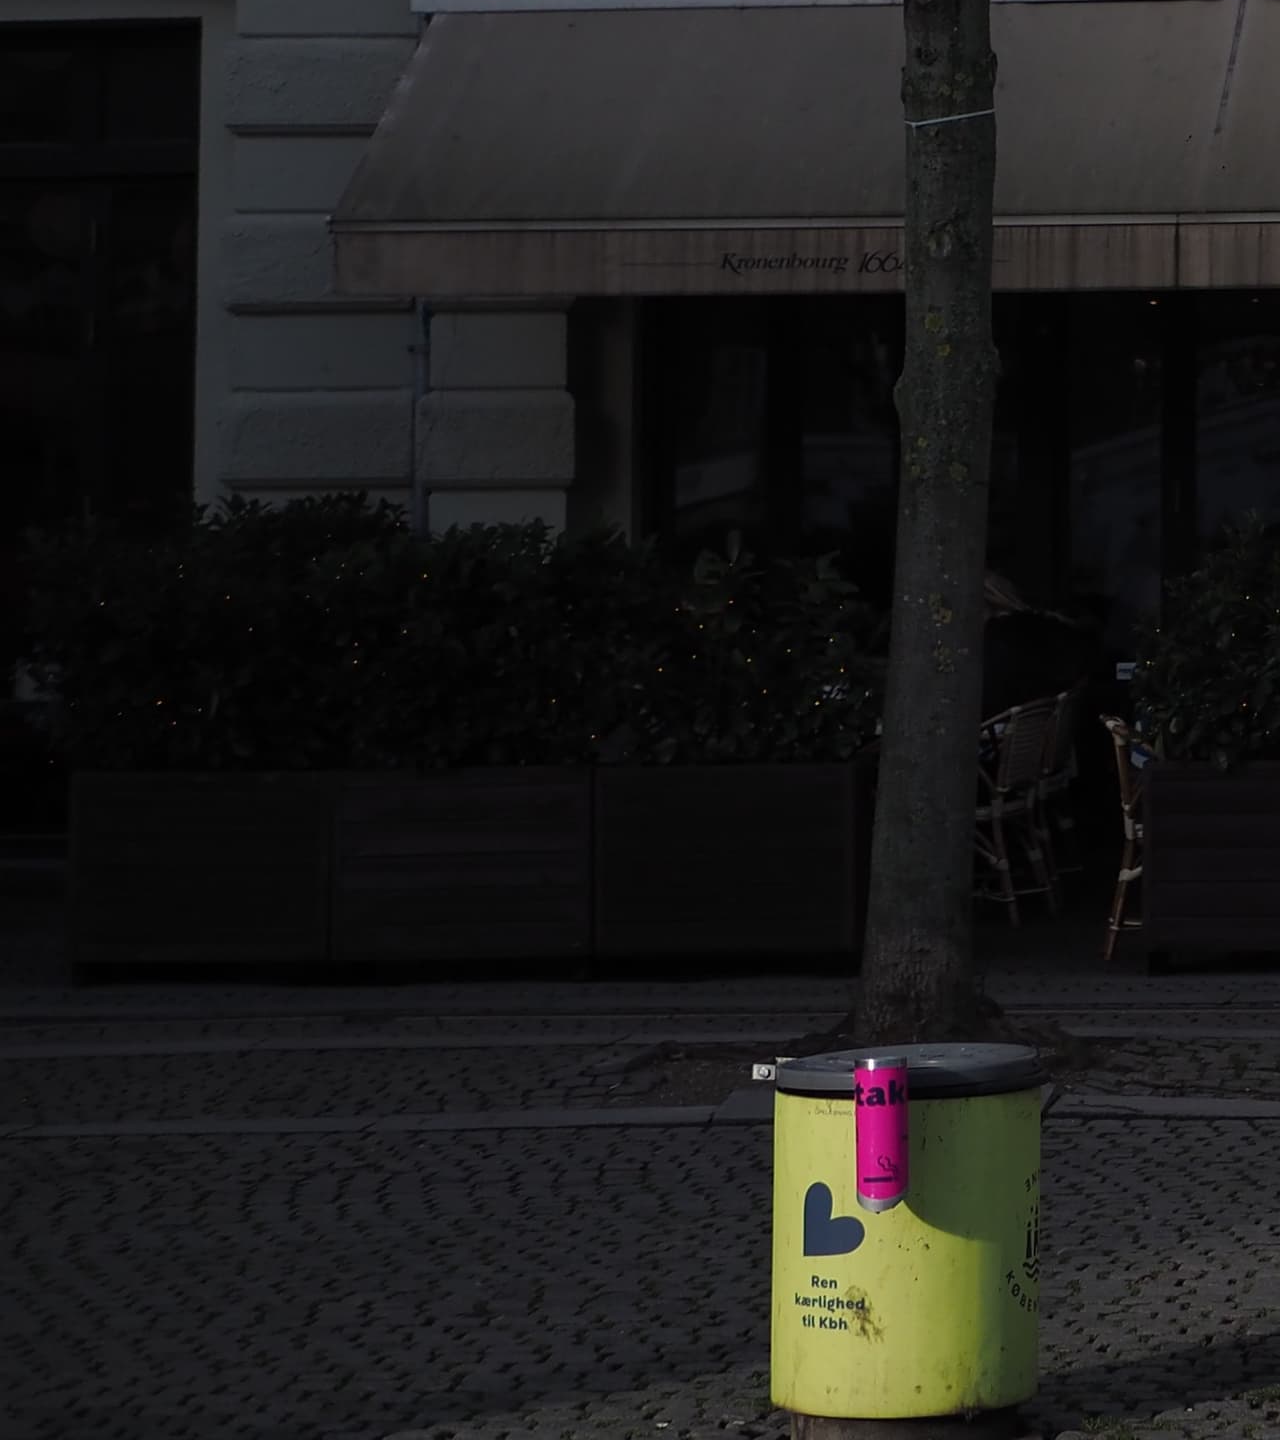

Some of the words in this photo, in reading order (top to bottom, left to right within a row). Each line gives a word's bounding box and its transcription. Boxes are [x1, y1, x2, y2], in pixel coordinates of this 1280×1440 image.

[720, 251, 849, 275] Kronenbourg
[857, 248, 905, 274] 166
[855, 1079, 905, 1107] tak
[811, 1274, 838, 1290] Ren
[794, 1292, 866, 1313] kærlighed
[802, 1314, 816, 1328] til
[818, 1315, 848, 1331] Kbh
